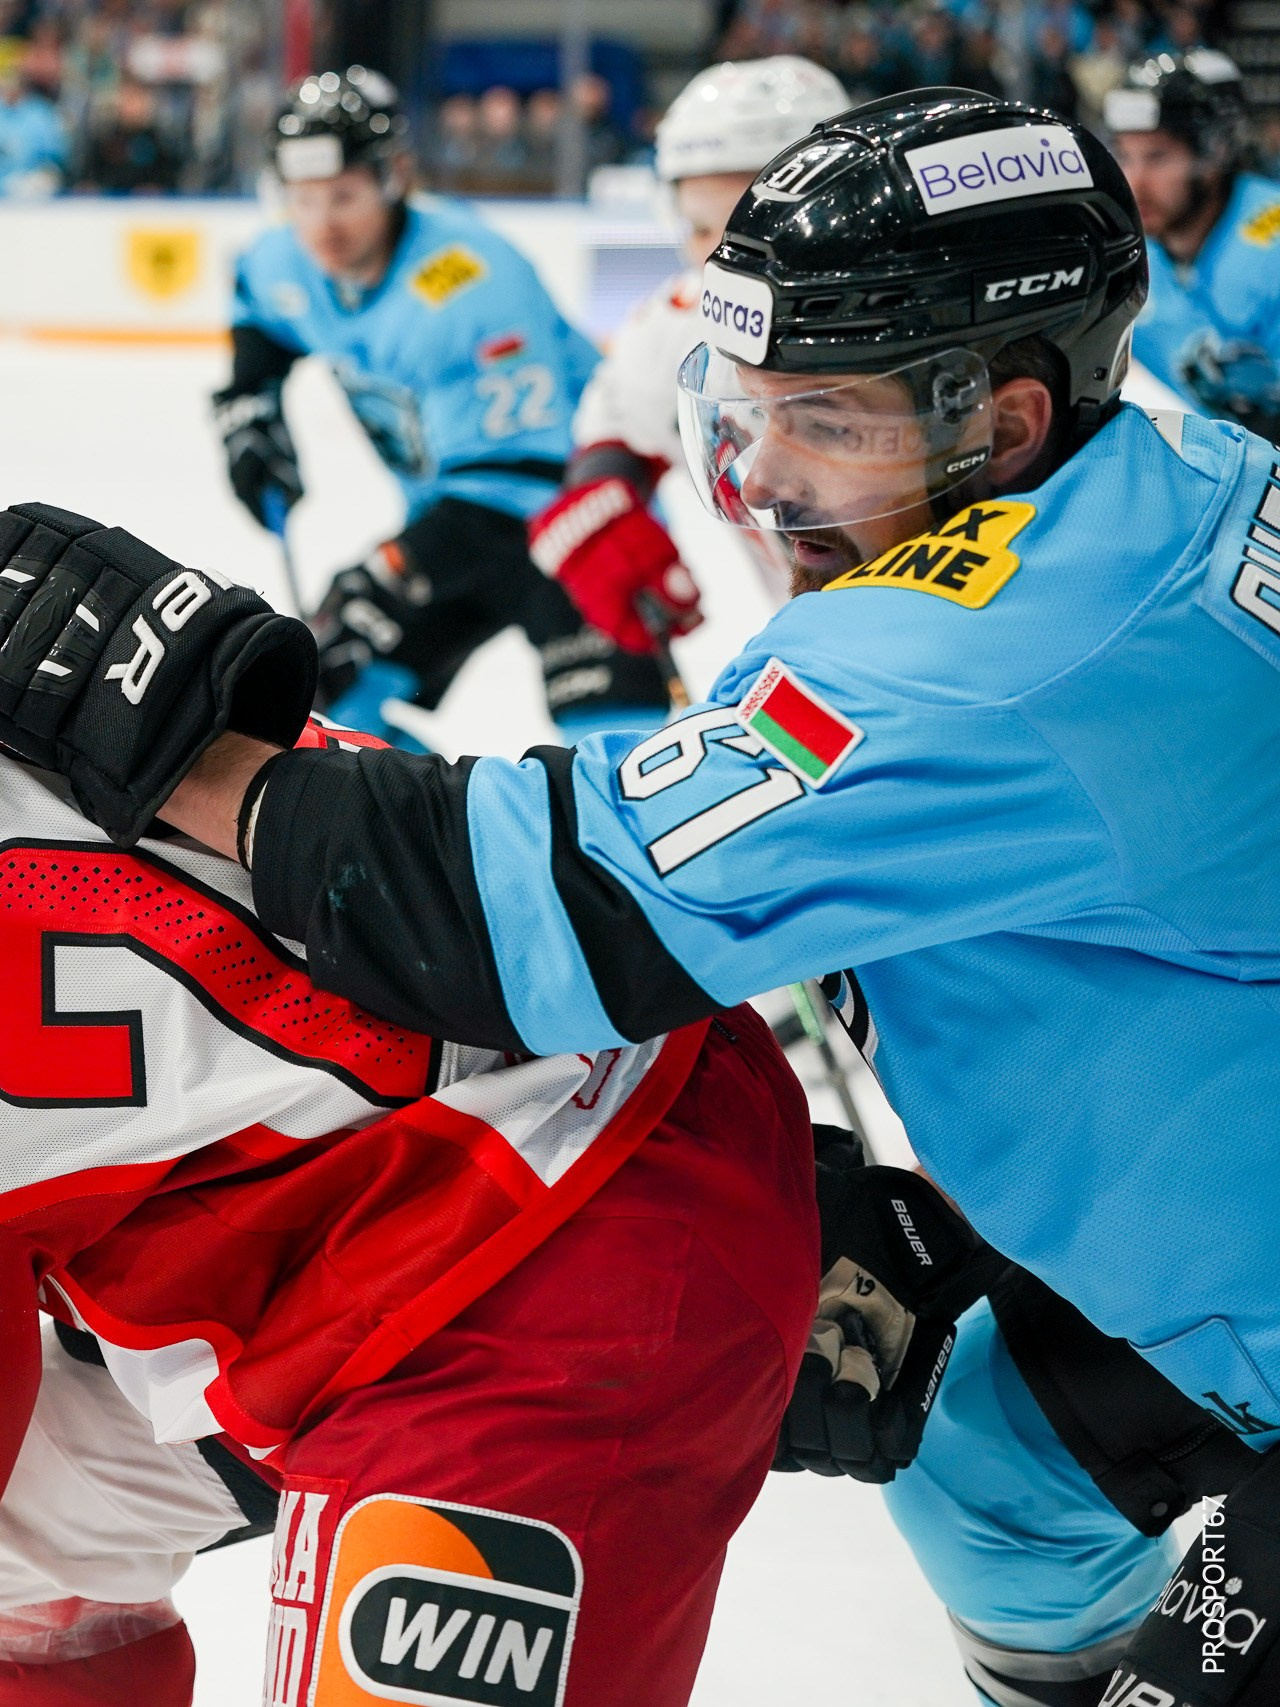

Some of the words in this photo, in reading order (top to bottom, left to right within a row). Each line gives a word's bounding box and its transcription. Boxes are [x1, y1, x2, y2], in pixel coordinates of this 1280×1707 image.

[919, 138, 1085, 200] Belavia
[702, 289, 764, 338] согаз
[983, 266, 1085, 303] CCM
[477, 364, 556, 439] 22
[946, 451, 987, 474] CCM
[846, 543, 991, 592] LINE
[616, 704, 810, 880] 61
[890, 1198, 933, 1267] BAUER
[920, 1334, 954, 1413] BAUER
[380, 1596, 554, 1693] WIN
[1150, 1565, 1268, 1656] lavia
